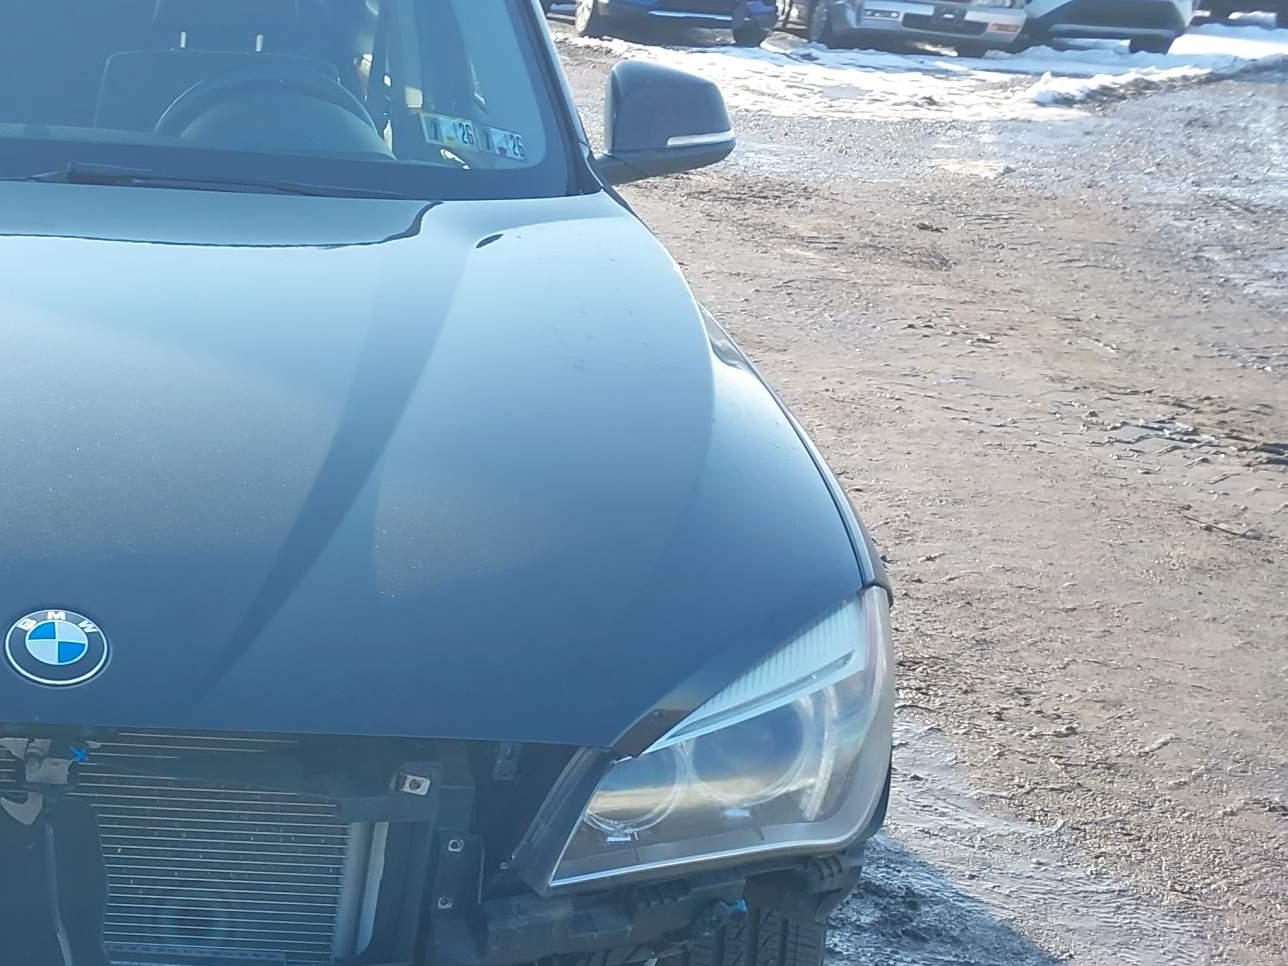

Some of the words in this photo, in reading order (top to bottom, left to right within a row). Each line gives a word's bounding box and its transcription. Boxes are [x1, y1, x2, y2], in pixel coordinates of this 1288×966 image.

[458, 122, 475, 145] 26
[509, 134, 525, 158] 26
[16, 611, 99, 633] BMW
